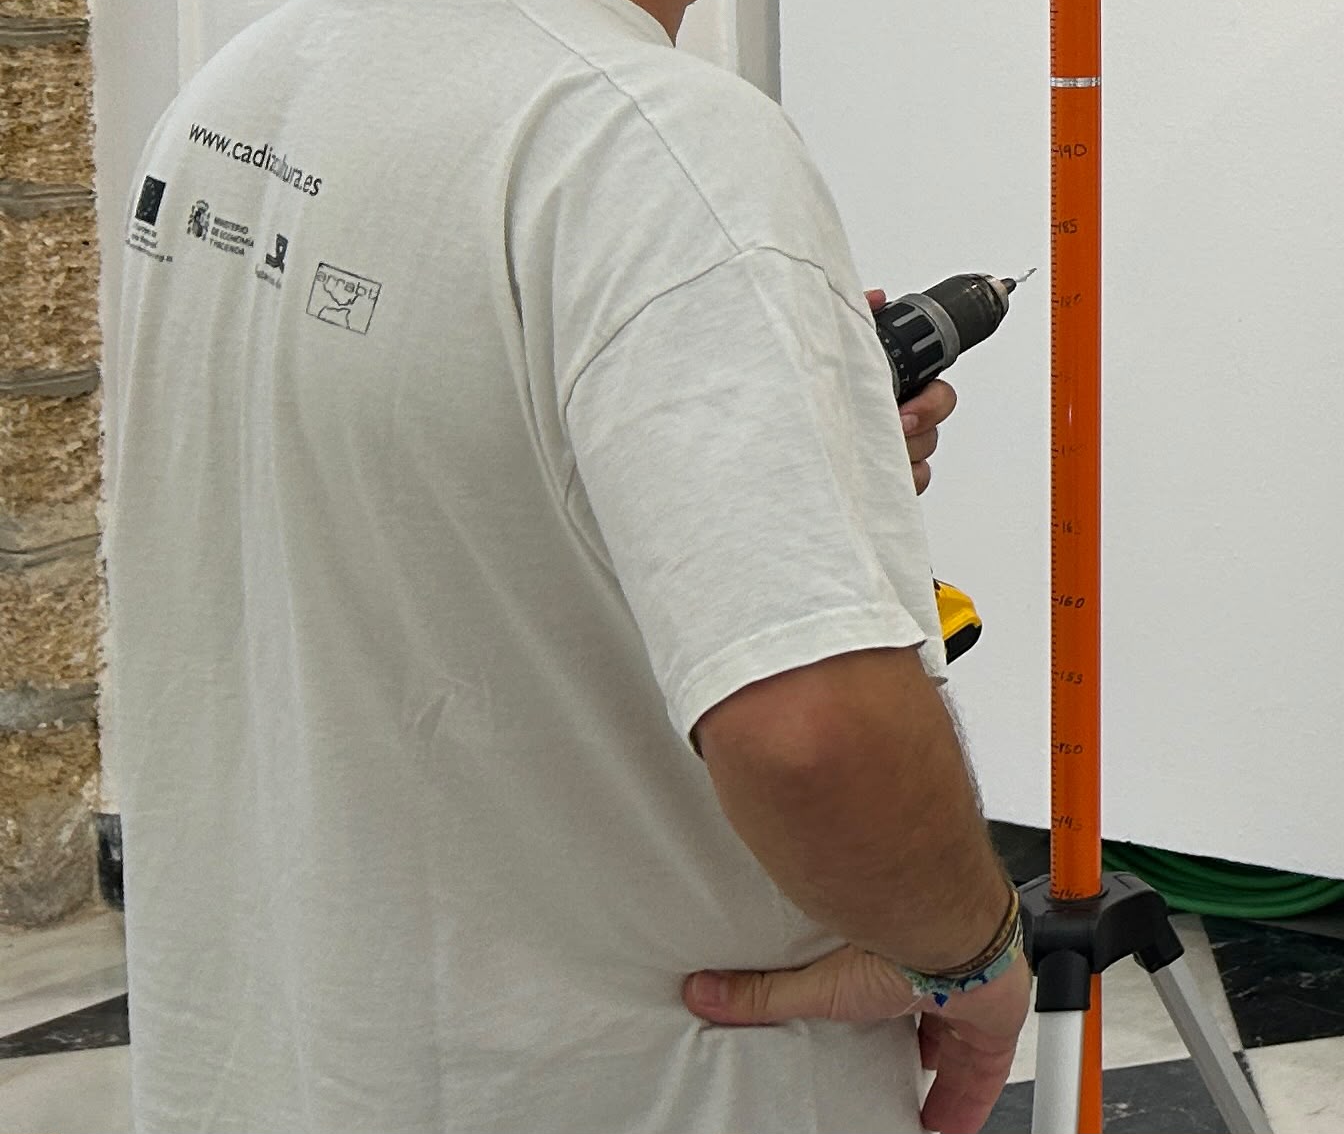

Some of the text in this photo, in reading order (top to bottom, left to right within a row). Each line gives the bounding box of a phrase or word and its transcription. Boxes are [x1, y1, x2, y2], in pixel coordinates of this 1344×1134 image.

[1058, 143, 1088, 159] 190
[1057, 218, 1078, 235] 185
[1058, 595, 1086, 610] 160
